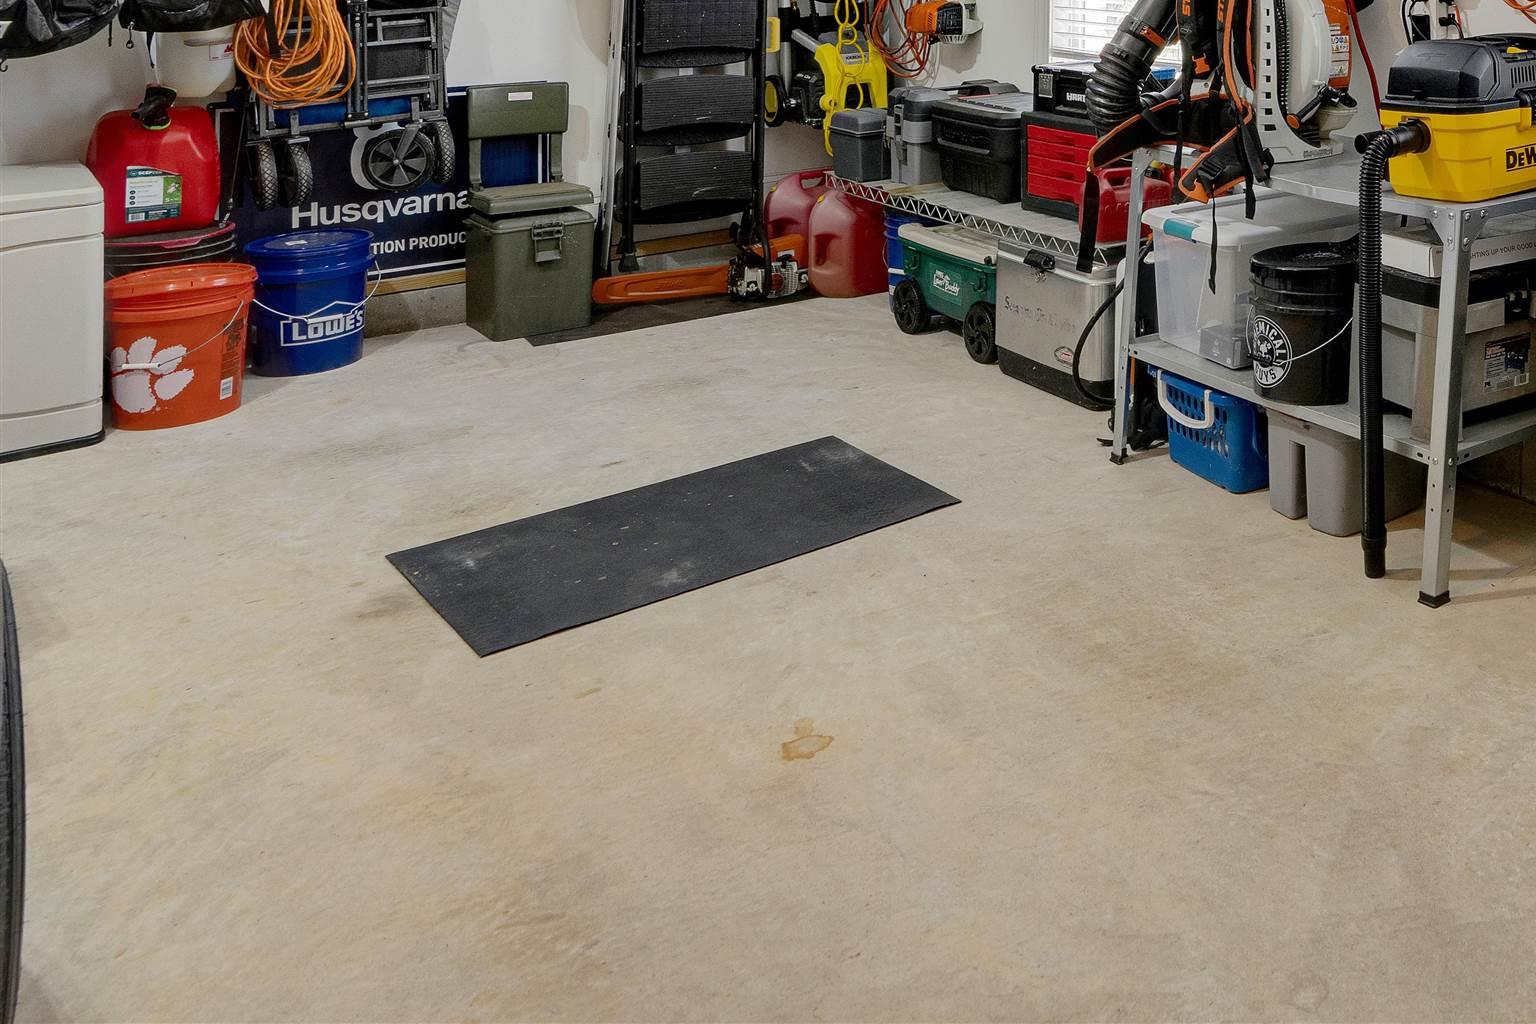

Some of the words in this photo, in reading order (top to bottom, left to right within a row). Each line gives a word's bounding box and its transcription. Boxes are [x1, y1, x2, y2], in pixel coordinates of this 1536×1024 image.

[291, 189, 472, 229] Husqvarna
[409, 231, 467, 250] PRODUC
[1500, 245, 1516, 254] YOUR
[1516, 243, 1533, 251] GOOD
[292, 309, 365, 342] LOWE'S
